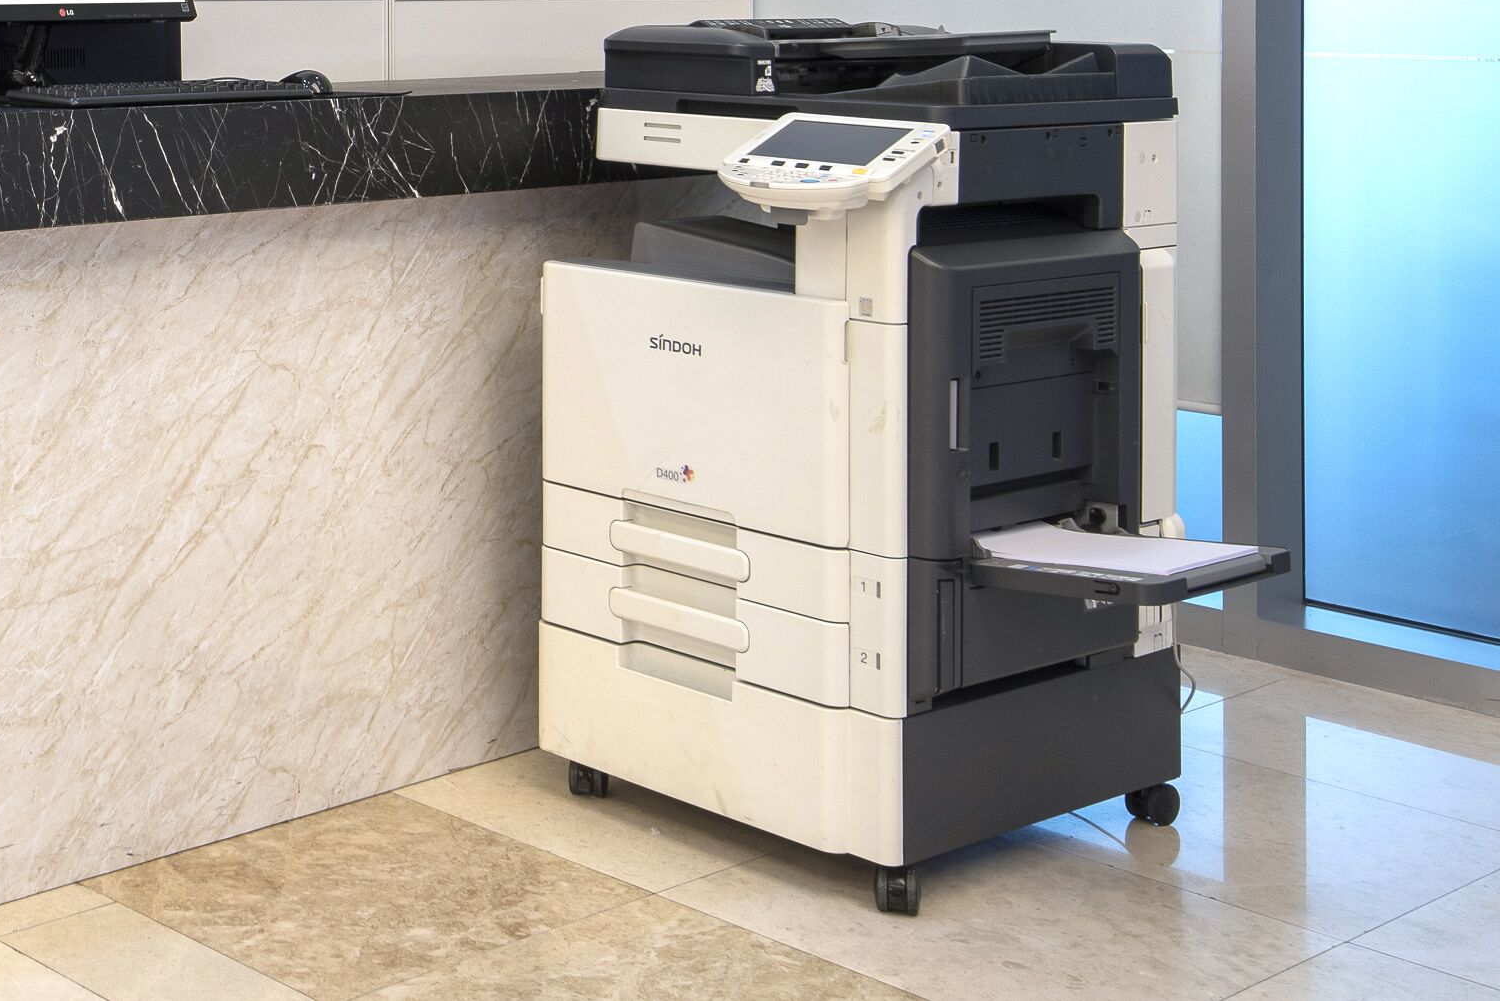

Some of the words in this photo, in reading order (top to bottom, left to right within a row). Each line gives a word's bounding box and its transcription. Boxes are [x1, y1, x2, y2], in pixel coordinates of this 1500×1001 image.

[656, 467, 679, 482] D400
[860, 581, 866, 592] 1
[860, 652, 868, 664] 2
